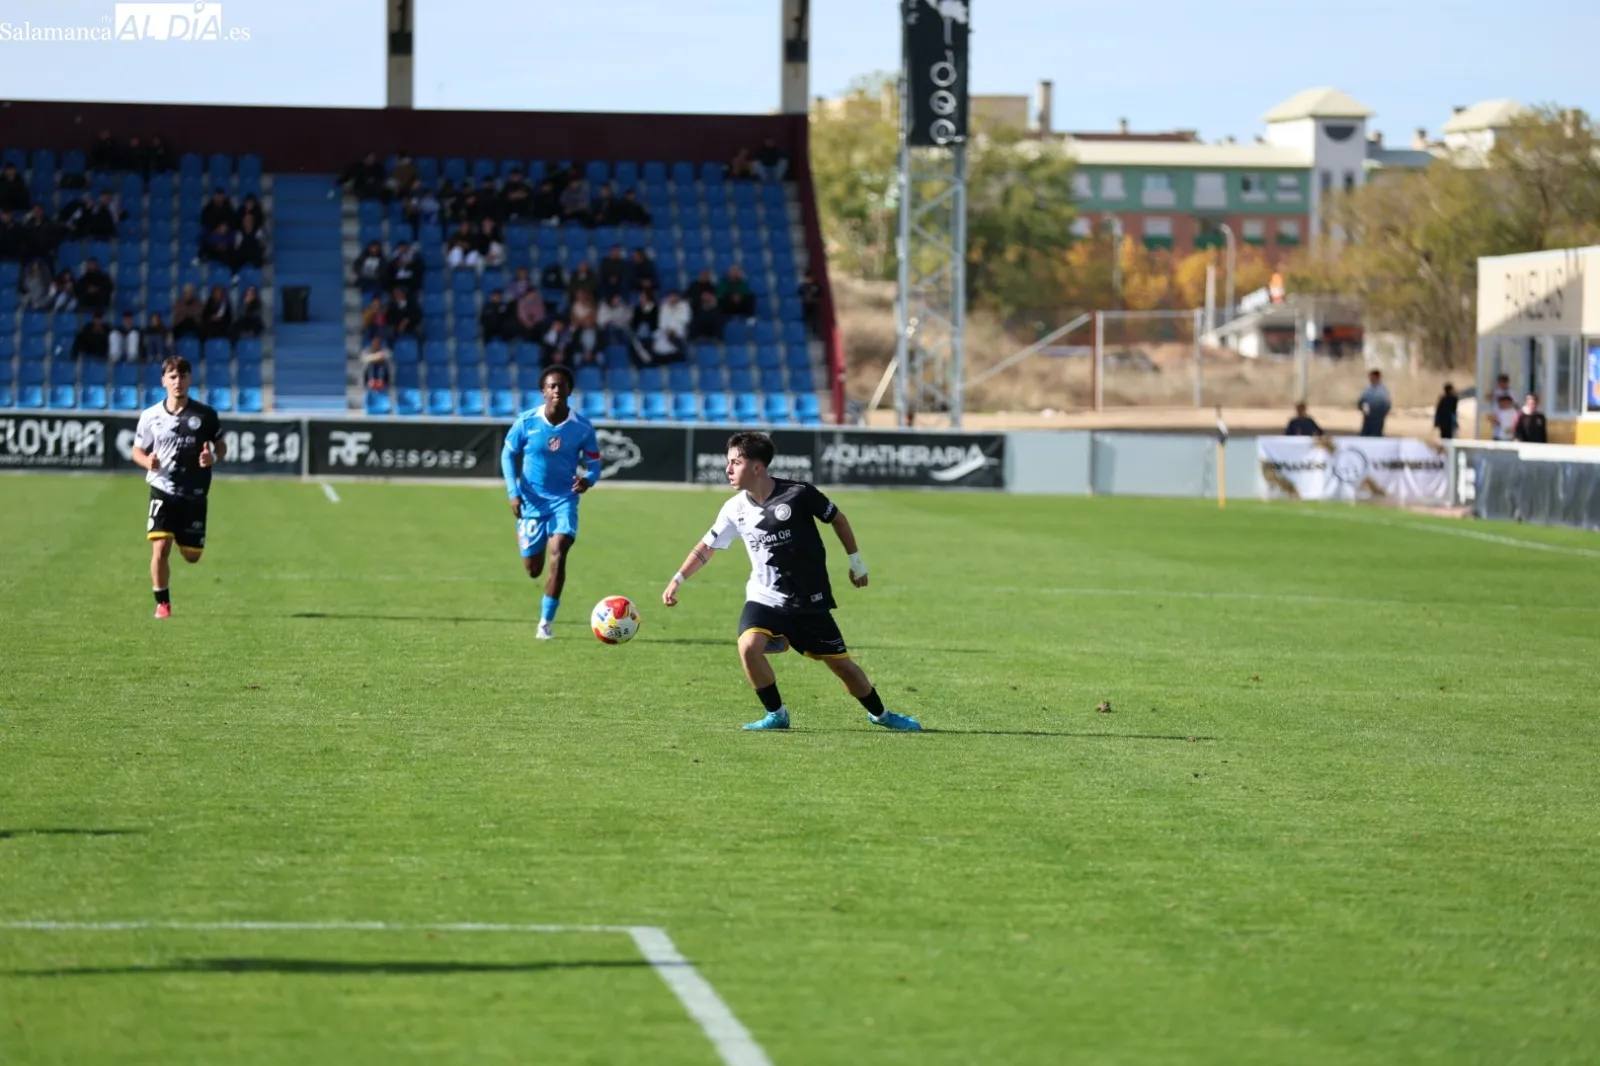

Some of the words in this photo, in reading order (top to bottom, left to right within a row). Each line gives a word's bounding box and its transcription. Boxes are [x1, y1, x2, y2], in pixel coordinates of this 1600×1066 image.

[820, 444, 984, 468] AQUATHERAPIA
[148, 499, 163, 517] 17
[760, 534, 777, 544] Don
[778, 529, 791, 540] QR
